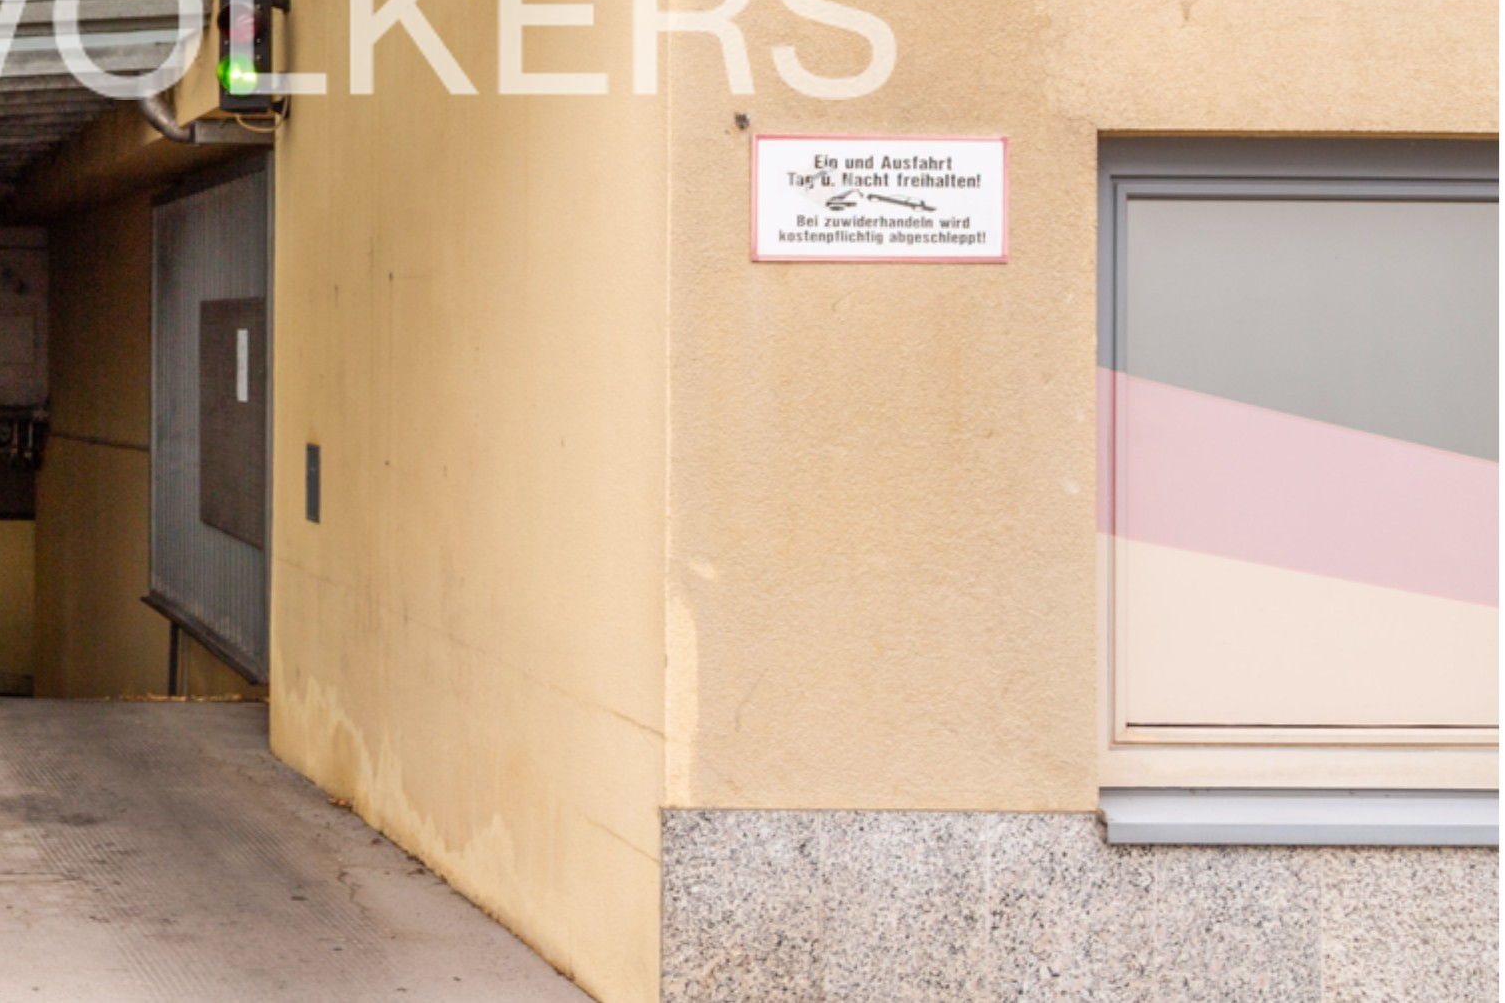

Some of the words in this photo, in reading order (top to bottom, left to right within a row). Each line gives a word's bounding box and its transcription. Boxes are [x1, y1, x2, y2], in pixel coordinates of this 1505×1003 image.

[814, 154, 838, 169] Ein
[844, 155, 874, 169] und
[881, 155, 953, 171] Ausfahrt
[787, 172, 814, 190] Tag
[842, 172, 889, 187] Nacht
[897, 173, 982, 189] freihalten!
[797, 214, 819, 227] Bei
[824, 214, 934, 229] zuwiderhandeln
[939, 216, 970, 230] wird
[778, 229, 884, 245] kostenpflichtig
[889, 230, 987, 246] abgeschleppt!
